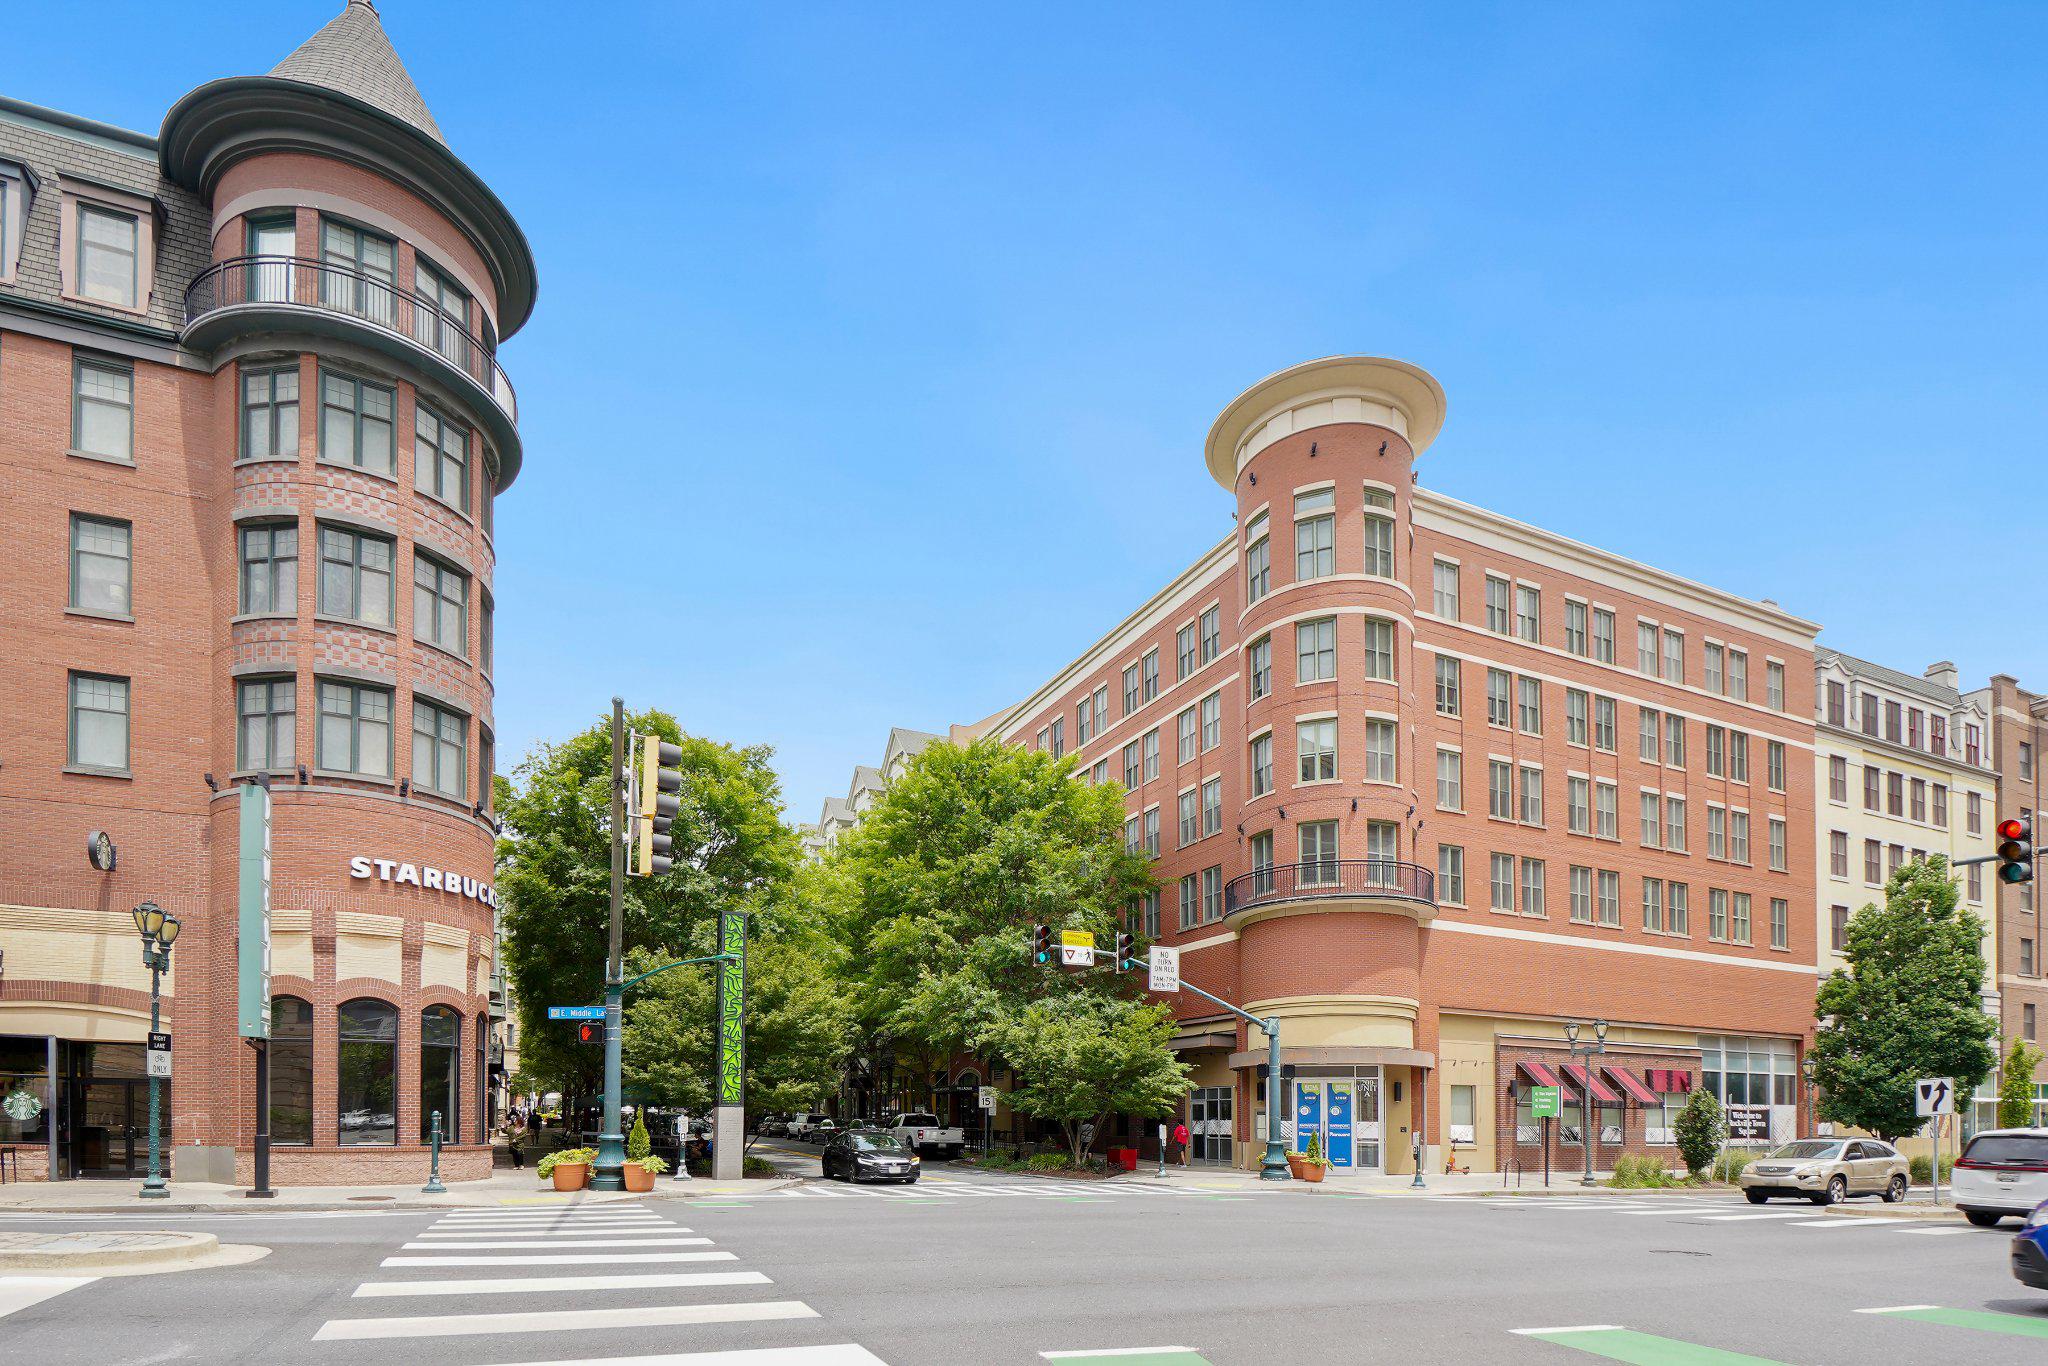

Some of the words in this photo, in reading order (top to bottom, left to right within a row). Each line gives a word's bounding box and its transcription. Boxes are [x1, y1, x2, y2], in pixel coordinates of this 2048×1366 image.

[1160, 951, 1169, 959] NO
[570, 1009, 592, 1017] Middle
[153, 1065, 167, 1073] ONLY
[1357, 1084, 1378, 1092] UNIT
